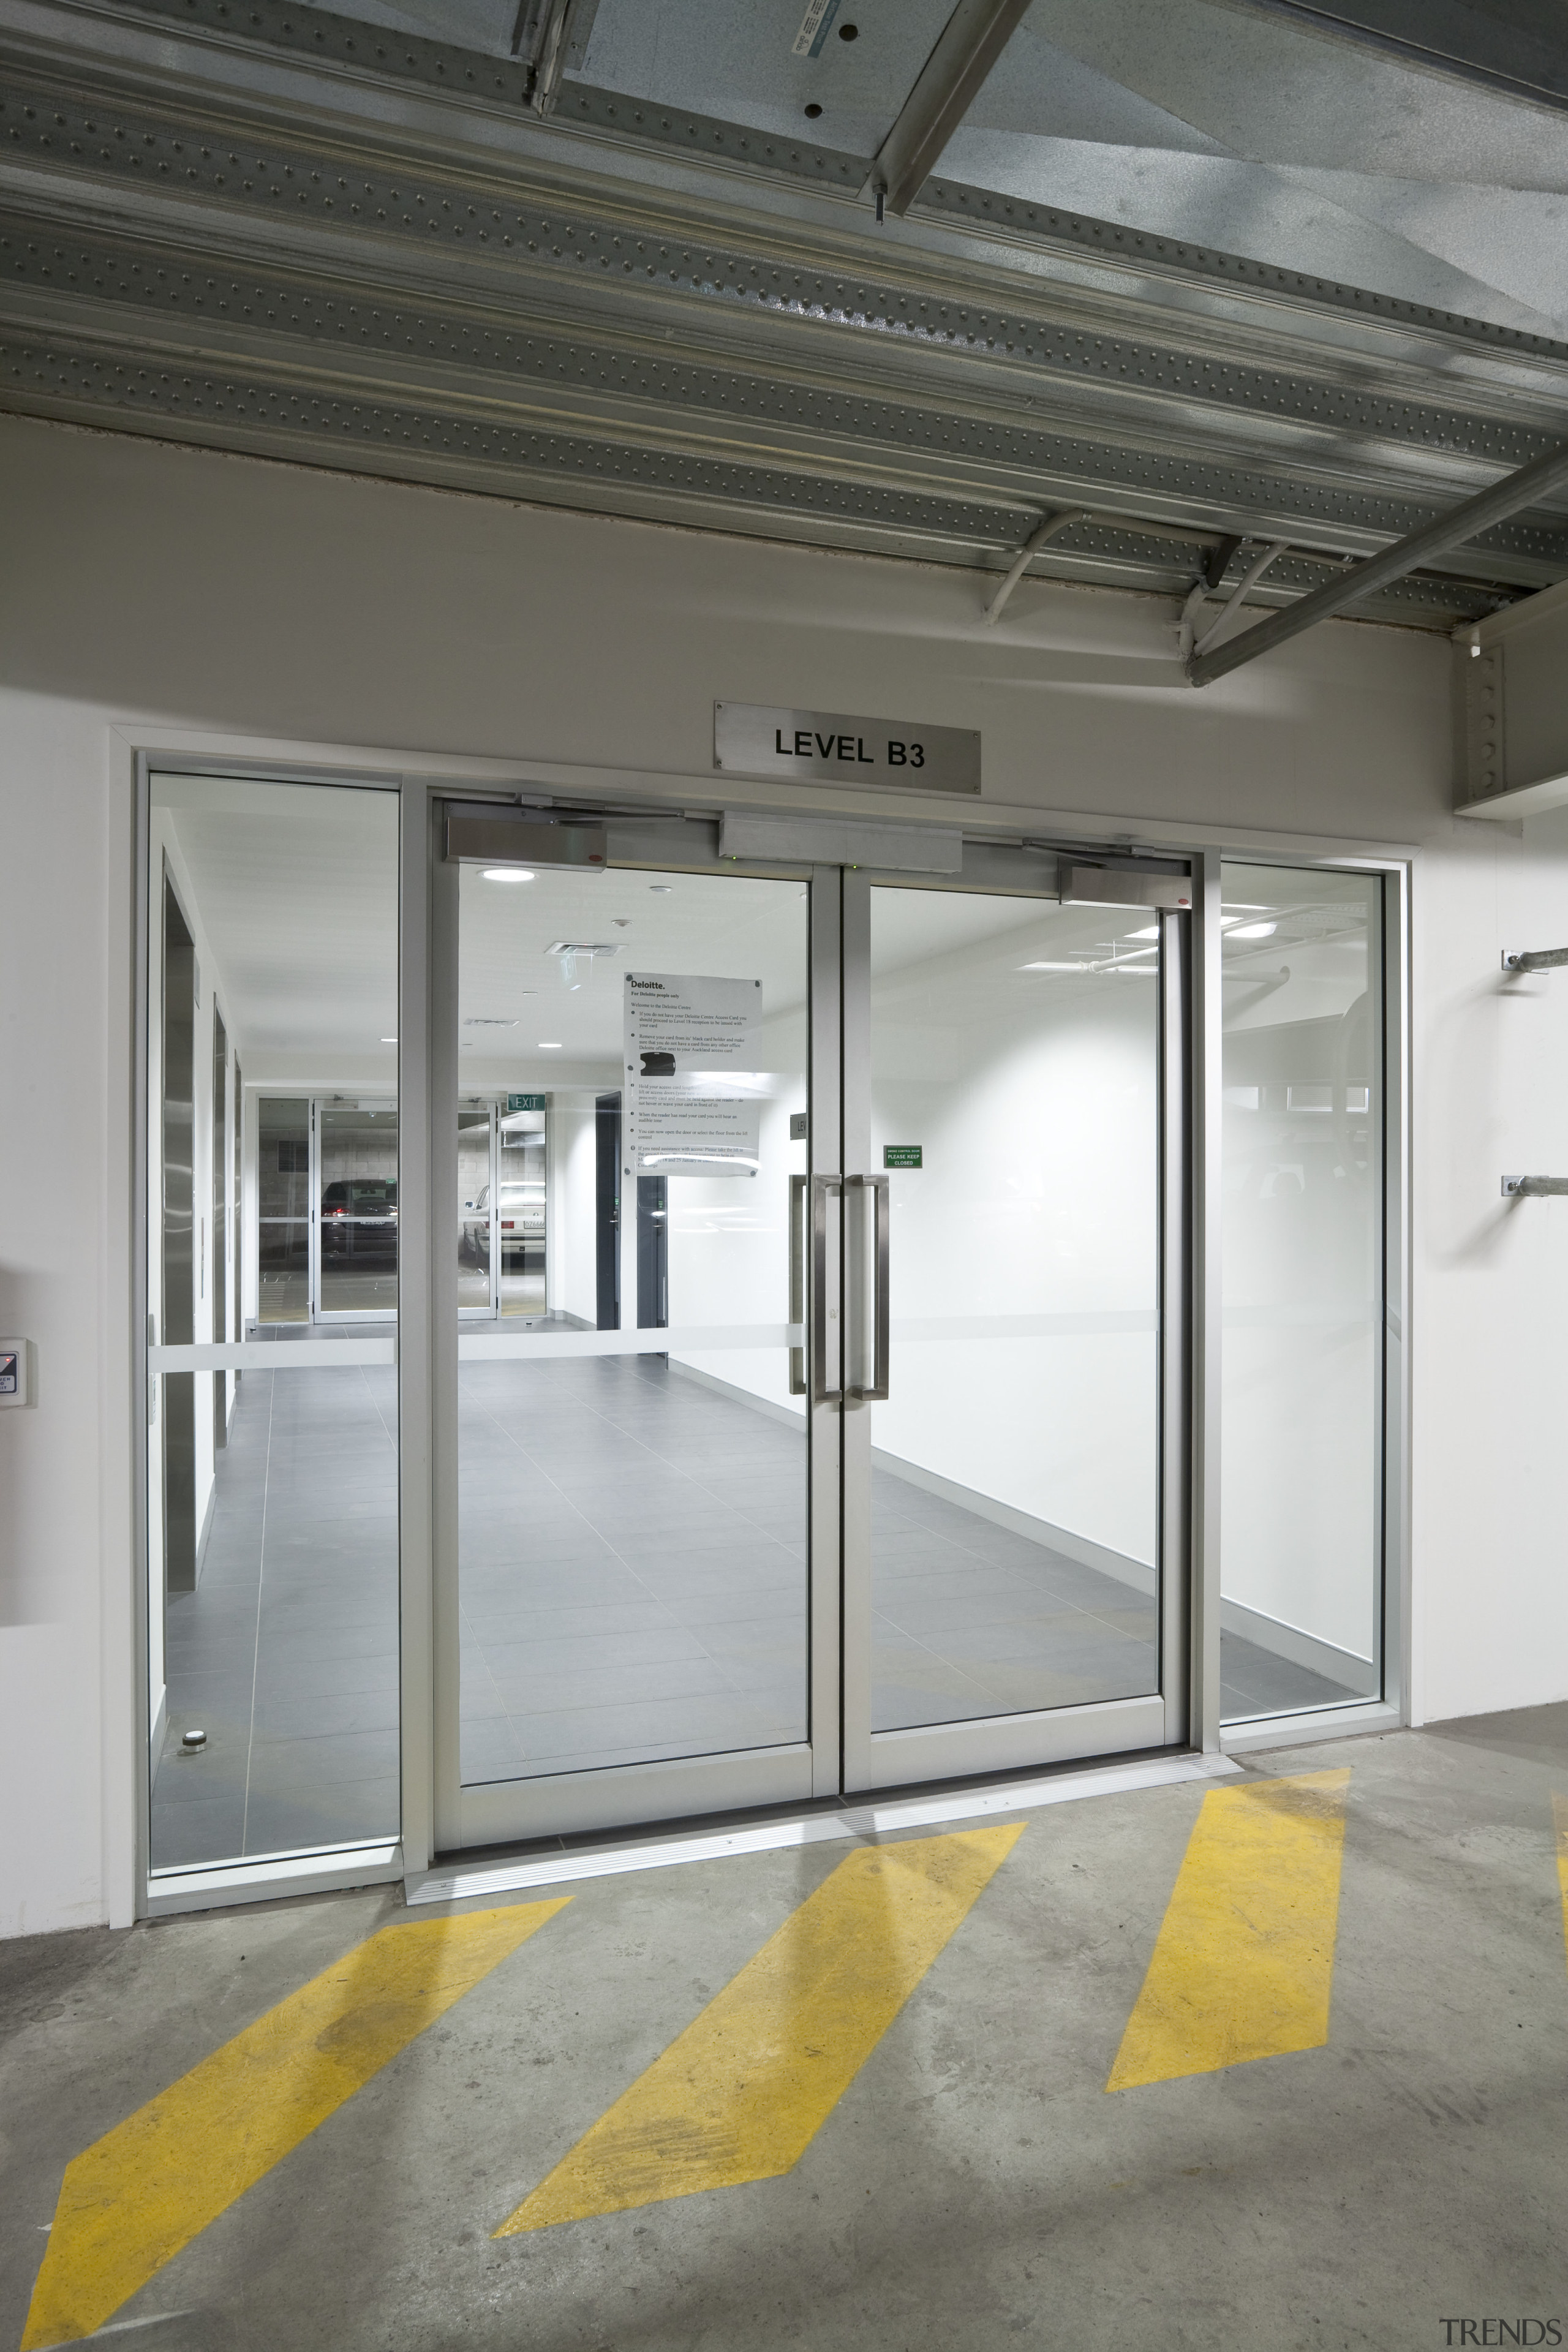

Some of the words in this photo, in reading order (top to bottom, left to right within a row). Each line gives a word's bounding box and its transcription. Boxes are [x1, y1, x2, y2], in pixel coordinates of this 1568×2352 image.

[776, 729, 874, 763] LEVEL
[888, 741, 925, 767] B3
[631, 981, 665, 989] Deloitte.
[516, 1097, 537, 1108] EXIT
[797, 1120, 807, 1131] LEV
